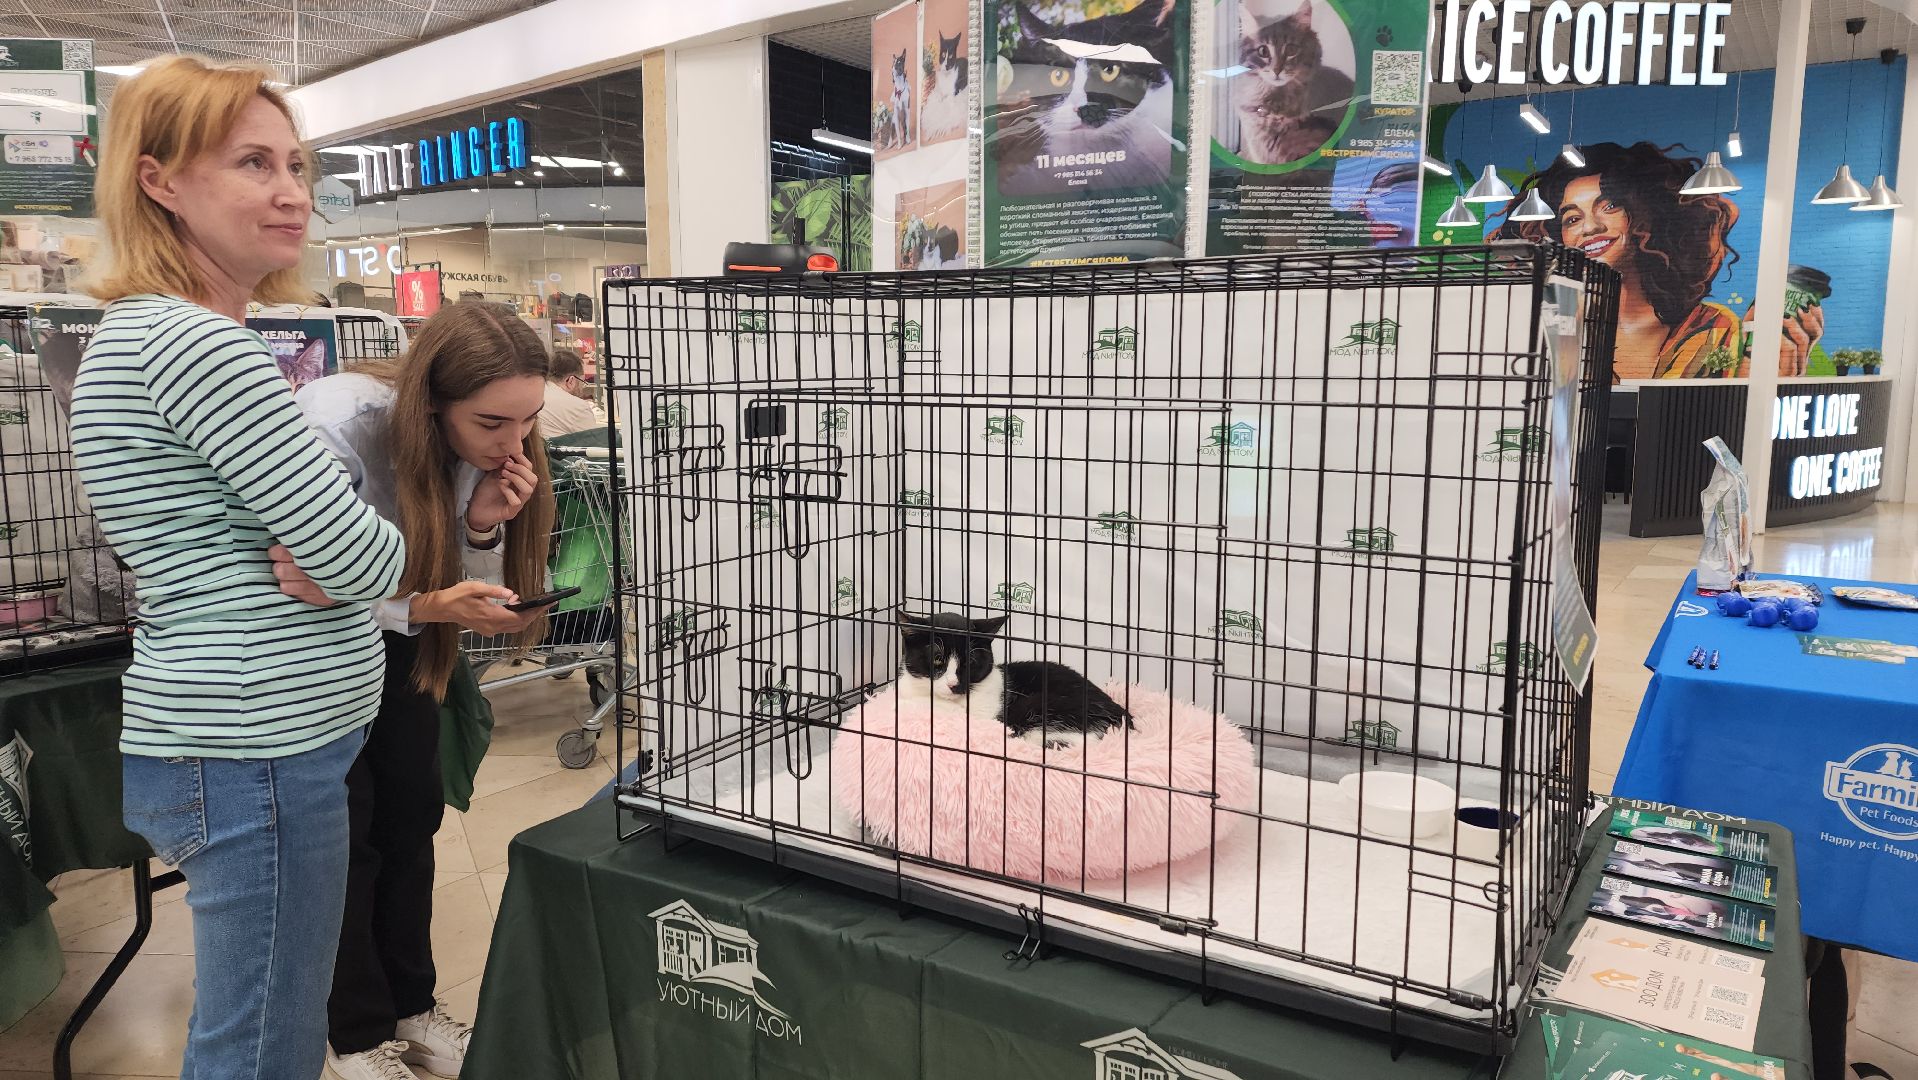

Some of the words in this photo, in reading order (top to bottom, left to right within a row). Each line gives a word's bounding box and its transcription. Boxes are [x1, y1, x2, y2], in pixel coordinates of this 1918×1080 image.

[1429, 0, 1530, 84] ICE
[1541, 0, 1731, 85] COFFEE
[1384, 129, 1414, 137] ЕЛЕНА
[419, 117, 526, 186] RINGER
[1036, 155, 1049, 168] 11
[1054, 150, 1126, 167] месяцев
[440, 272, 478, 282] УЖСКАЯ
[481, 274, 508, 284] ОБУВЬ
[62, 324, 96, 334] МОН
[261, 331, 306, 340] ХЕЛЬГА
[1814, 394, 1860, 438] LOVE
[1792, 454, 1834, 500] ONE
[1836, 446, 1882, 494] COFFEE
[1838, 773, 1918, 807] Farmi
[1682, 809, 1747, 824] ДОМ
[1860, 806, 1879, 819] Pet
[1883, 811, 1918, 828] Foods
[1820, 832, 1856, 849] Happy
[1858, 841, 1880, 850] pet.
[656, 978, 750, 1024] УЮТНЫЙ
[755, 1010, 802, 1046] ДОМ
